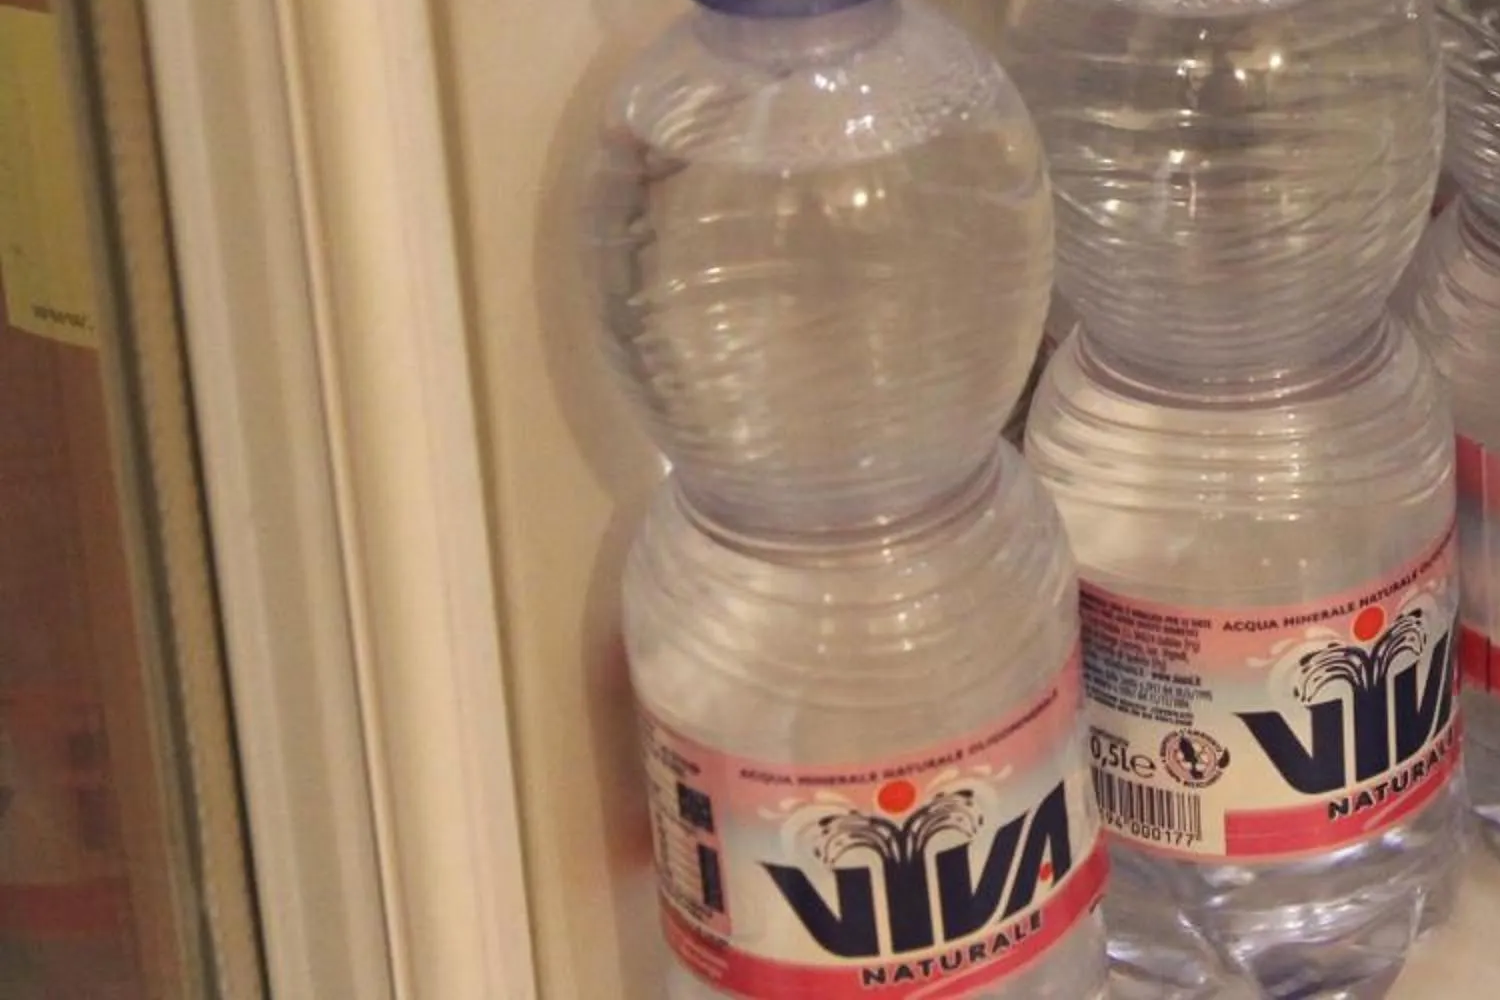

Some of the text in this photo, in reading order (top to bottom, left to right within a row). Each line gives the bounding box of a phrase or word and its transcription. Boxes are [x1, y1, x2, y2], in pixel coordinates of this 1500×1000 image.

[1222, 568, 1418, 633] ACQUA MINERALE NATURALE
[738, 768, 793, 786] ACQUA
[755, 779, 1073, 958] VIVA
[862, 912, 1044, 987] NATURALE
